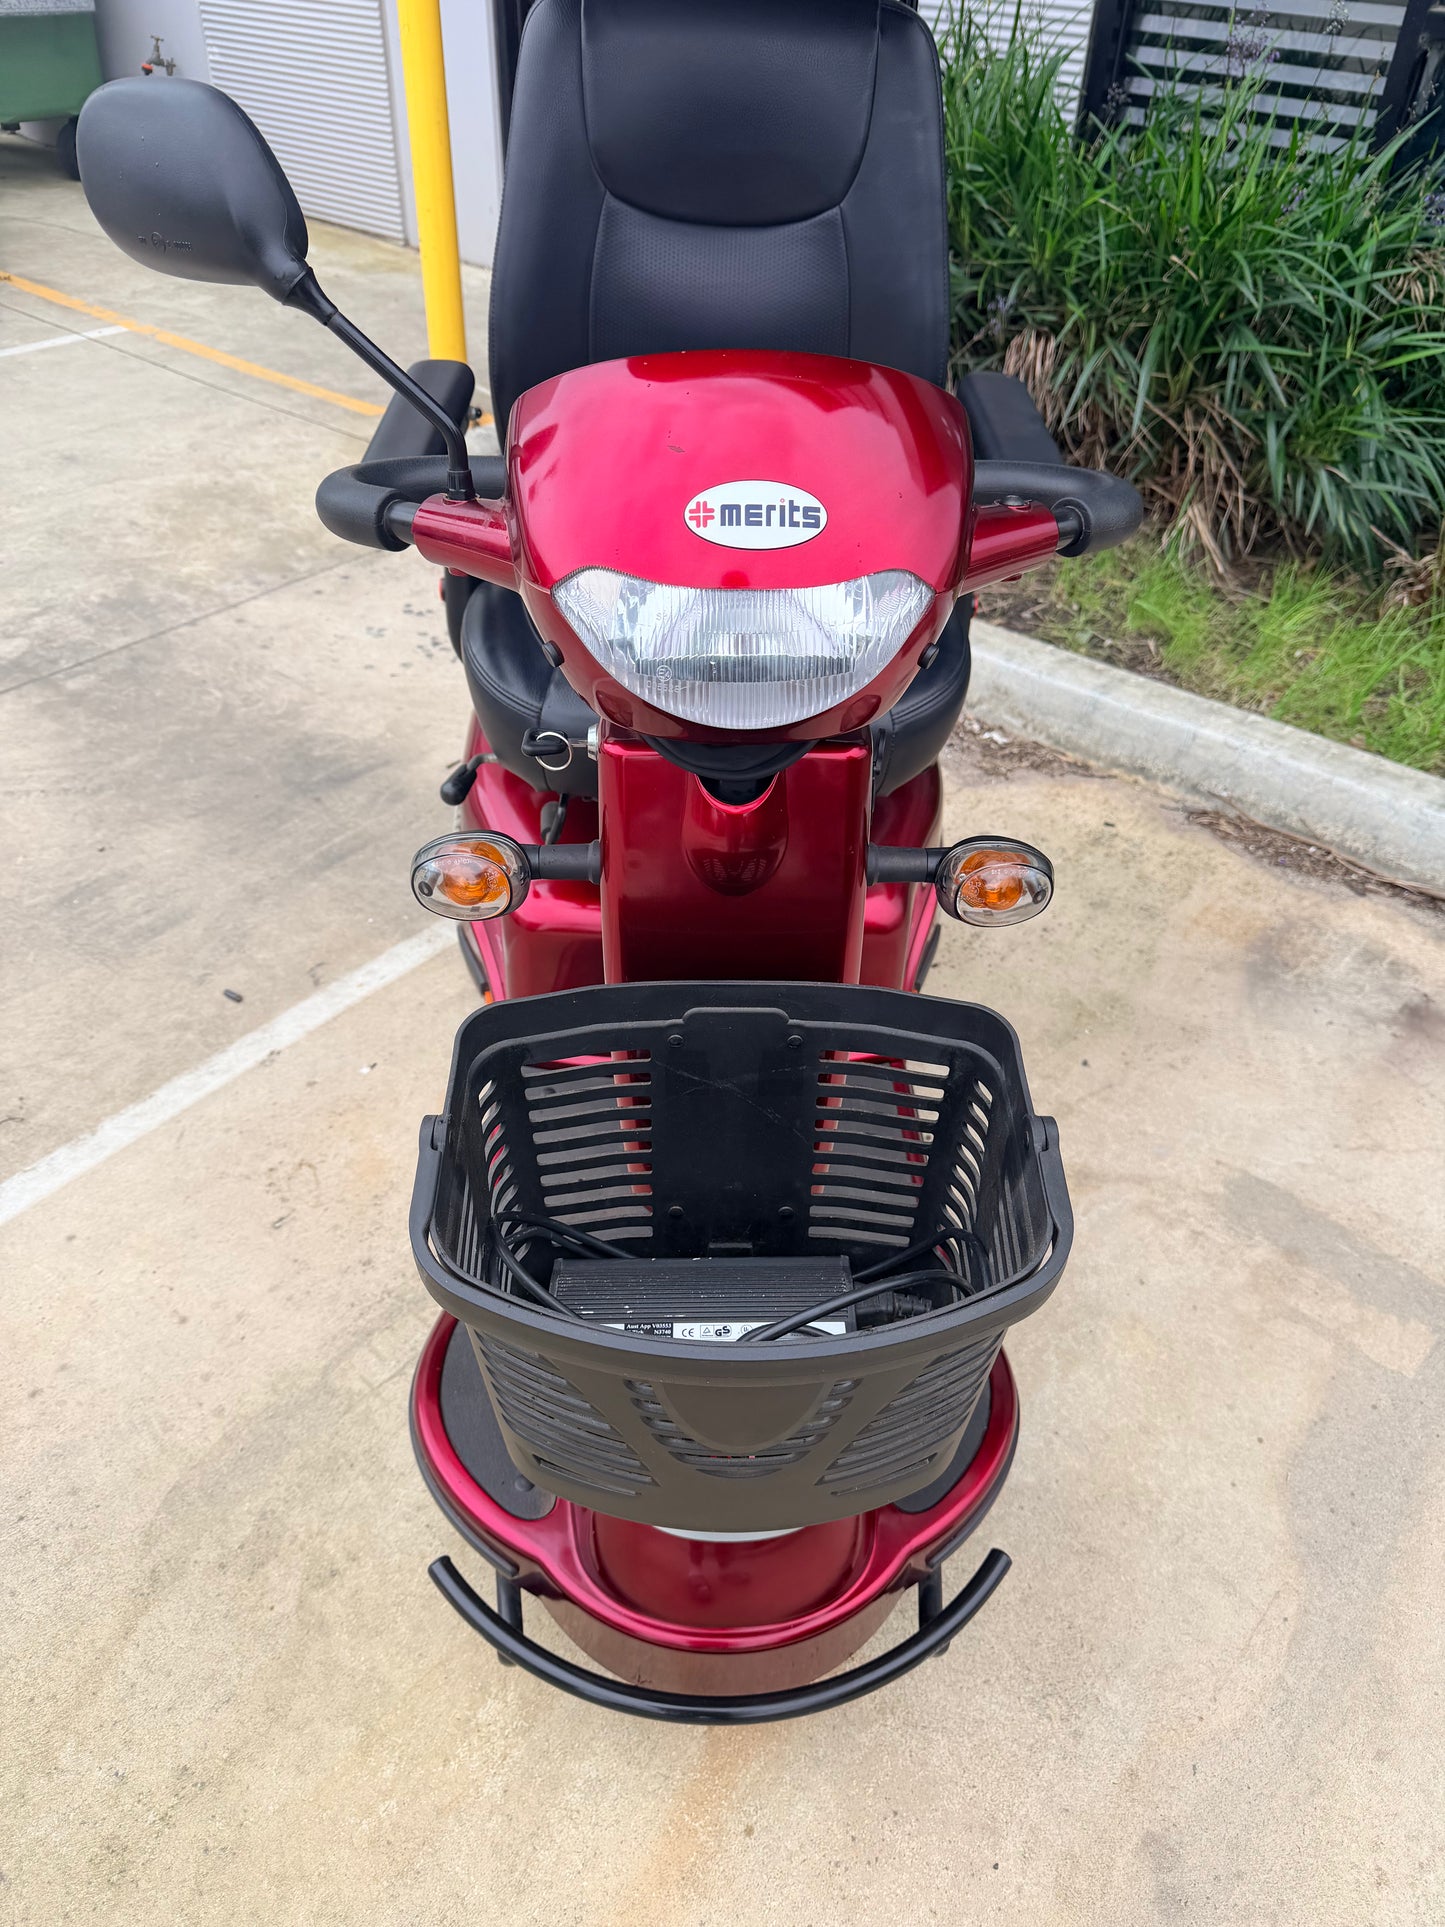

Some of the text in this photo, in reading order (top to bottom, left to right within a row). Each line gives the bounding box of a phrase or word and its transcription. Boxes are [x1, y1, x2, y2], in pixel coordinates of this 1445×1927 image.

[720, 498, 821, 529] merits
[681, 1328, 694, 1338] CE
[714, 1325, 731, 1337] GS
